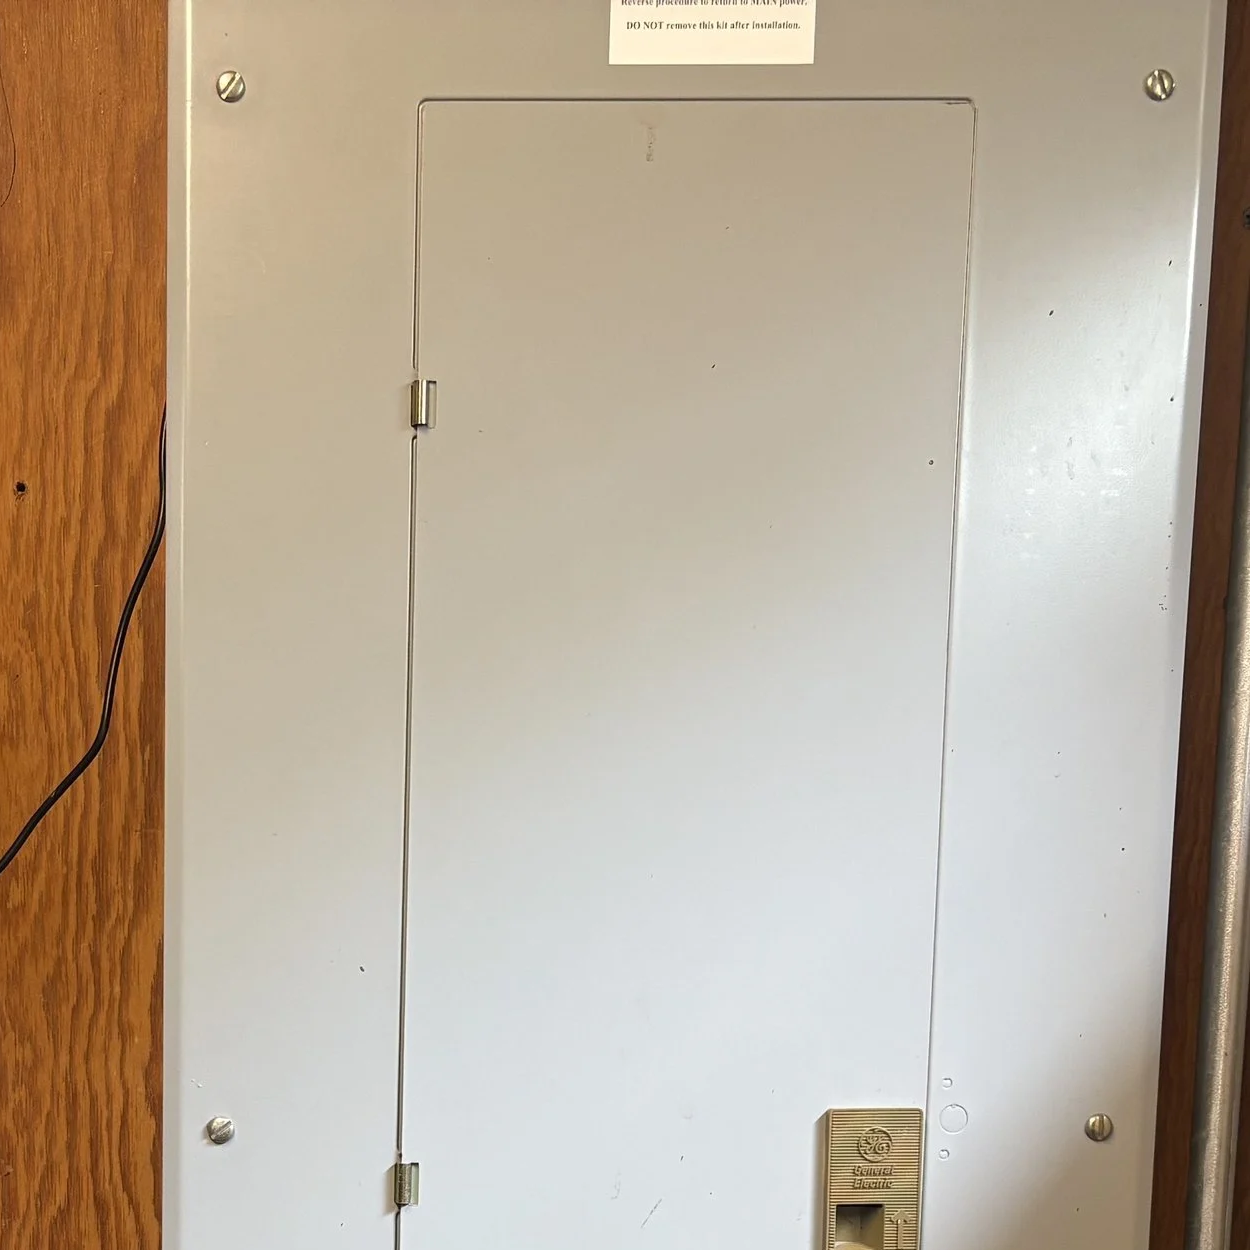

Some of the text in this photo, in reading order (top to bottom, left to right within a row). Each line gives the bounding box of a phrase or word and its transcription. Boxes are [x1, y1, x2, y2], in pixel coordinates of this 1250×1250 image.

[655, 0, 698, 8] procedure
[626, 20, 801, 30] DO NOT remove this kit after installation.
[853, 1165, 894, 1176] General
